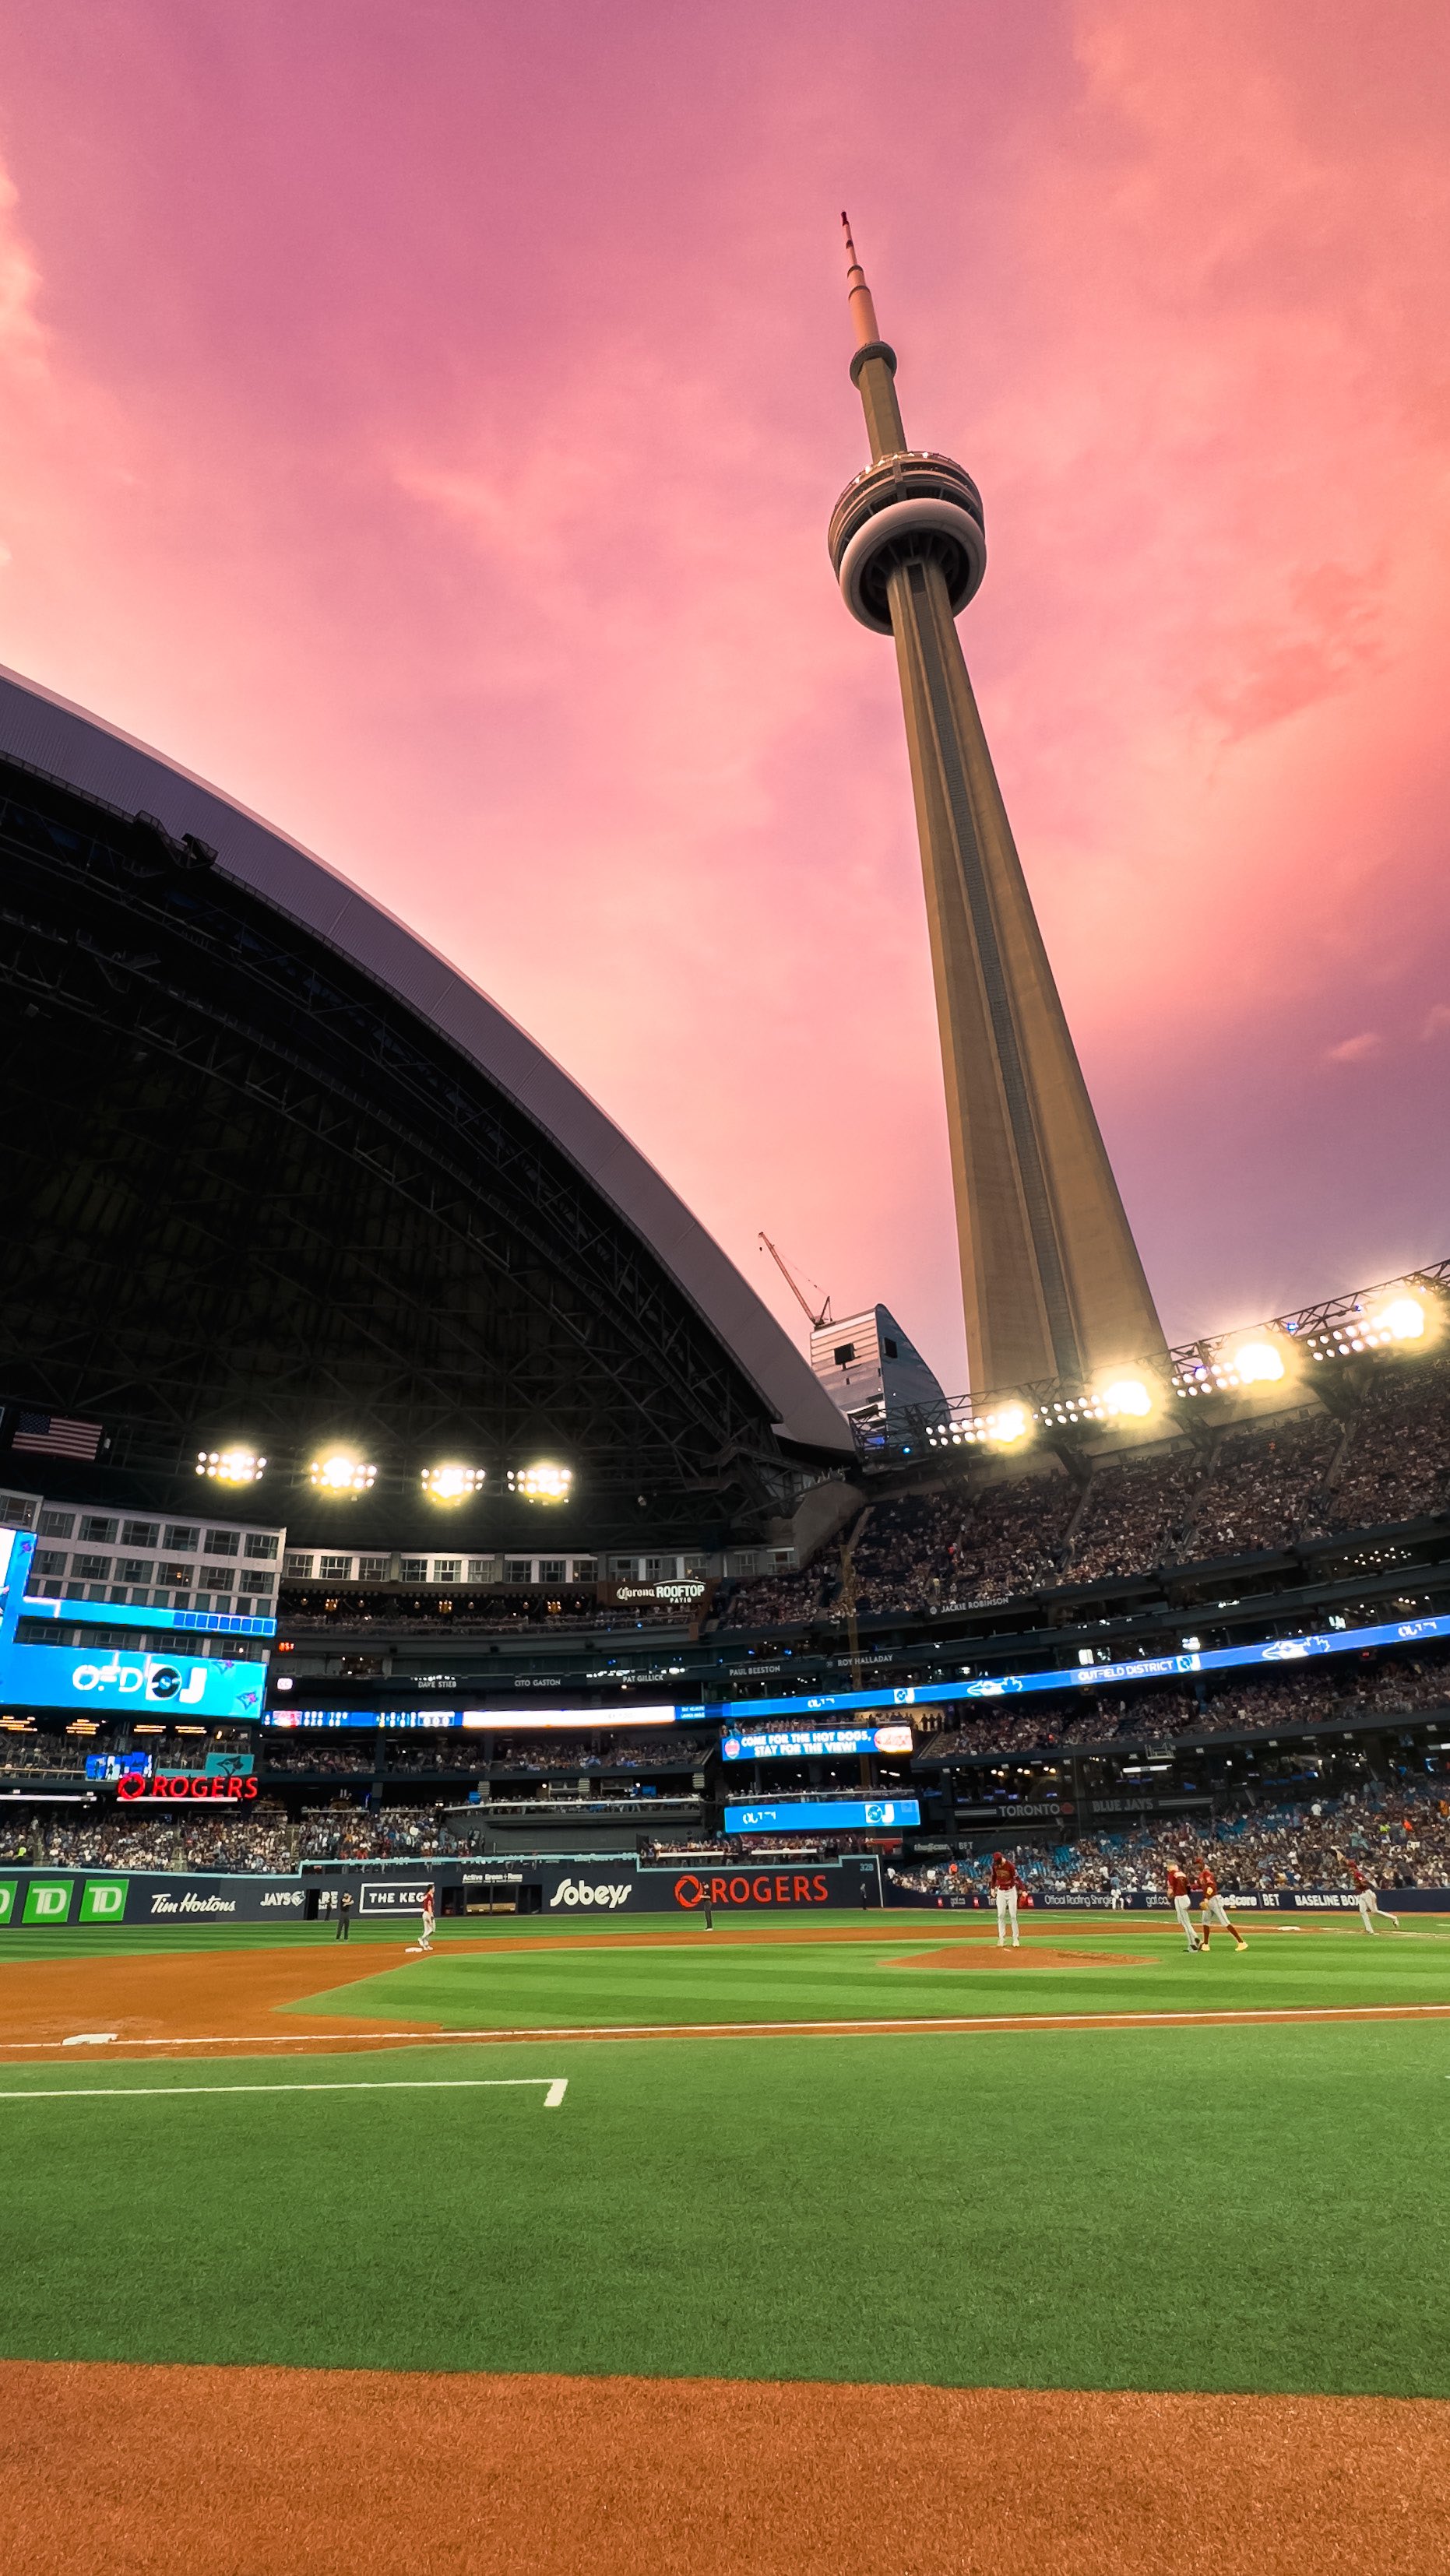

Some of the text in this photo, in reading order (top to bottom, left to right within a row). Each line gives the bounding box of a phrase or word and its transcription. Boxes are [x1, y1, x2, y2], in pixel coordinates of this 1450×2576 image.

[616, 1585, 705, 1601] Corona ROOFTOP
[941, 1603, 966, 1613] JACKIE
[968, 1597, 1008, 1609] ROBINSON
[837, 1658, 852, 1667] ROY
[854, 1654, 893, 1665] HALLADAY
[748, 1665, 781, 1675] BEESTON
[1078, 1661, 1174, 1682] OUTFIELD DISTRICT
[533, 1678, 561, 1687] GASTON
[637, 1674, 663, 1682] GILLICK
[741, 1735, 767, 1747] COME
[769, 1734, 789, 1745] FOR
[790, 1733, 811, 1744] THE
[812, 1731, 835, 1743] HOT
[837, 1730, 871, 1741] DOGS,
[754, 1745, 778, 1757] STAY
[780, 1744, 801, 1755] FOR
[803, 1742, 823, 1754] THE
[824, 1741, 857, 1753] VIEW!
[151, 1776, 258, 1799] ROGERS
[999, 1805, 1060, 1817] TORONTO
[1093, 1798, 1153, 1812] BLUE JAYS
[959, 1841, 973, 1850] BET
[859, 1863, 874, 1871] 328
[550, 1878, 632, 1909] Sobeys
[712, 1875, 829, 1904] ROGERS
[32, 1888, 68, 1915] TD
[89, 1887, 123, 1913] TD
[150, 1892, 237, 1914] Tim Hortons
[260, 1892, 291, 1907] JAYS
[369, 1892, 425, 1903] THE KEG
[1044, 1893, 1066, 1905] Official
[1066, 1893, 1090, 1907] Roofing
[1262, 1893, 1279, 1907] BET
[1294, 1894, 1340, 1907] BASELINE
